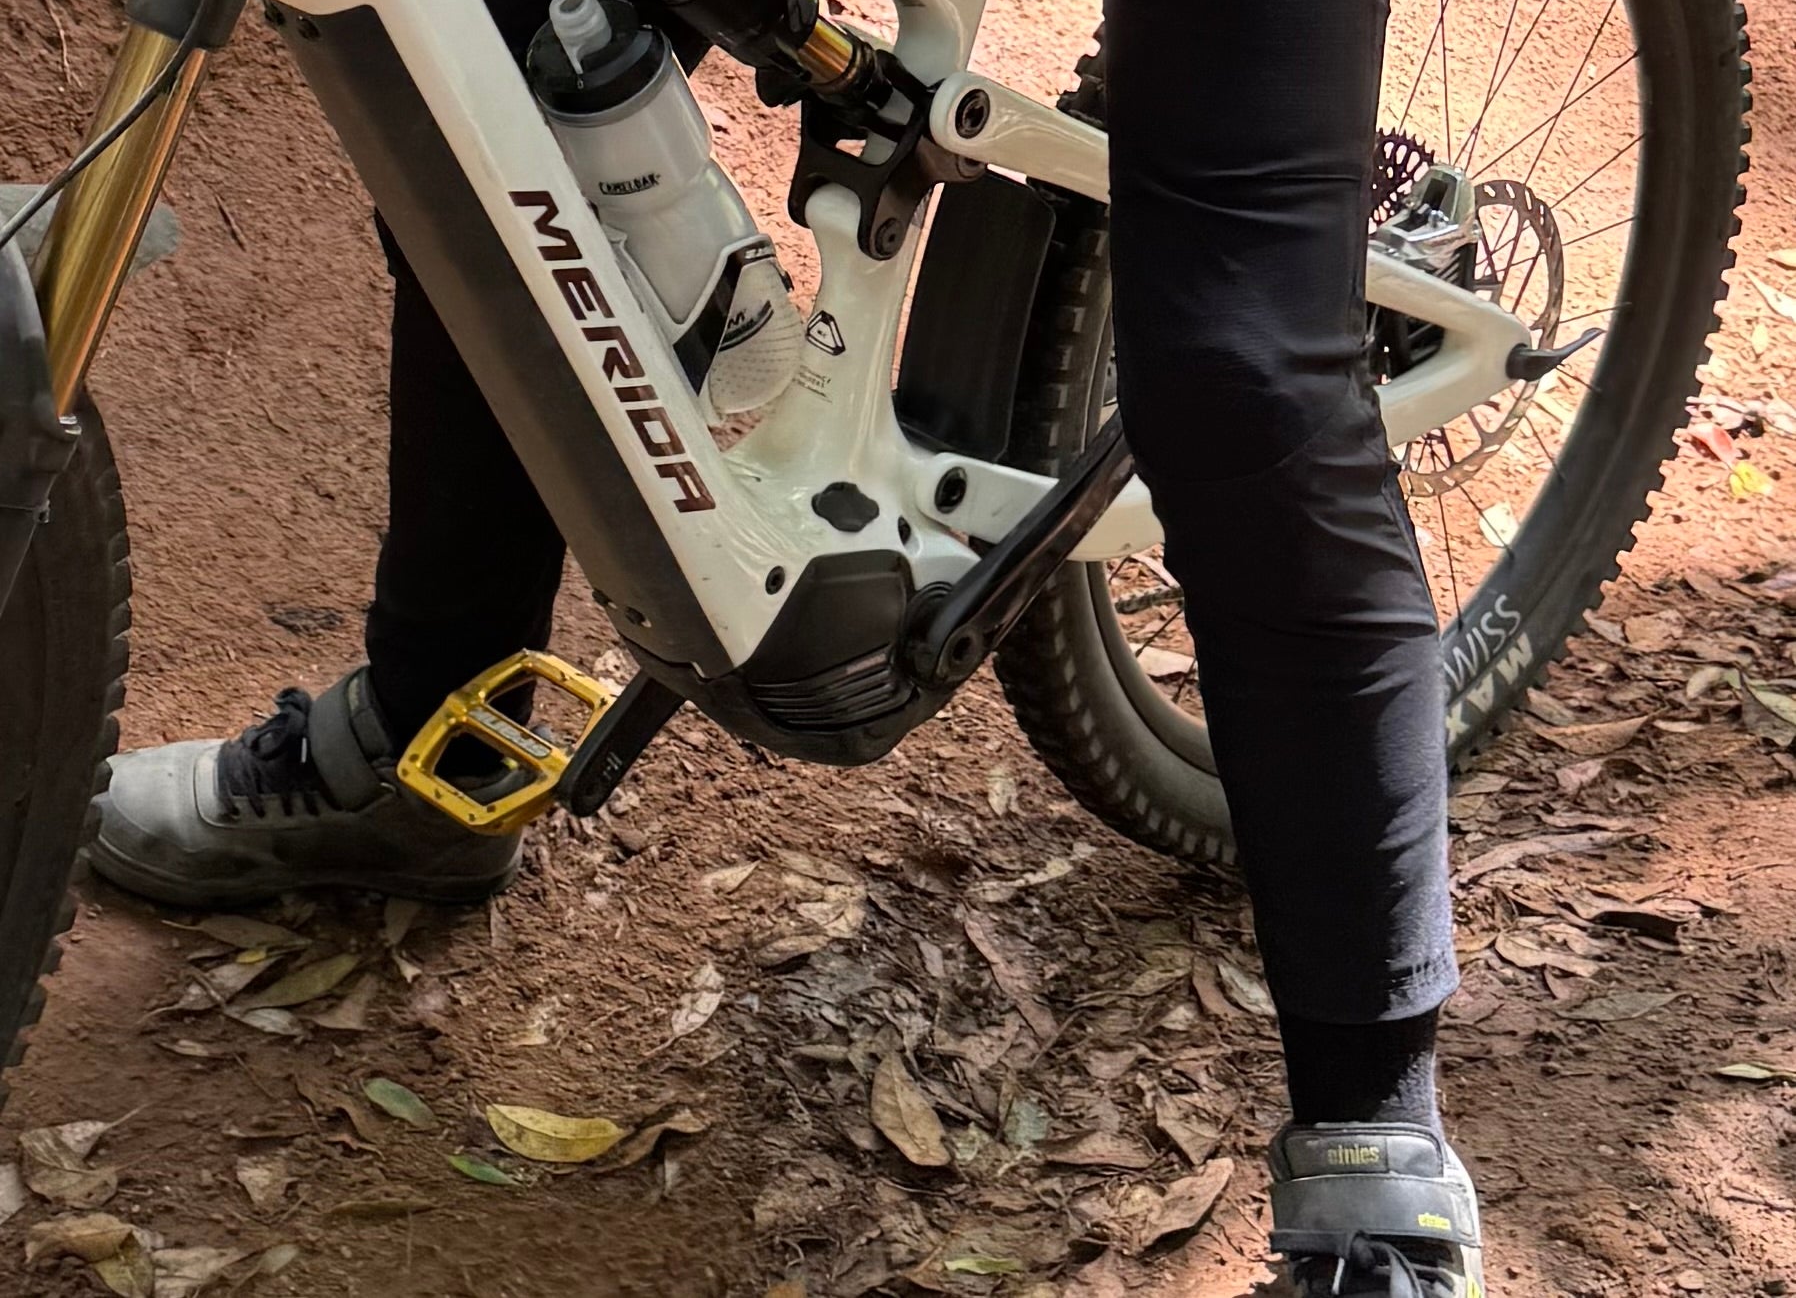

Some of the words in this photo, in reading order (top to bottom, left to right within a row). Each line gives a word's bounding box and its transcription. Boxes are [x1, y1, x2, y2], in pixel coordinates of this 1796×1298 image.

[508, 189, 717, 514] MERIDA
[1443, 593, 1522, 693] WISS
[1445, 631, 1534, 747] MAX
